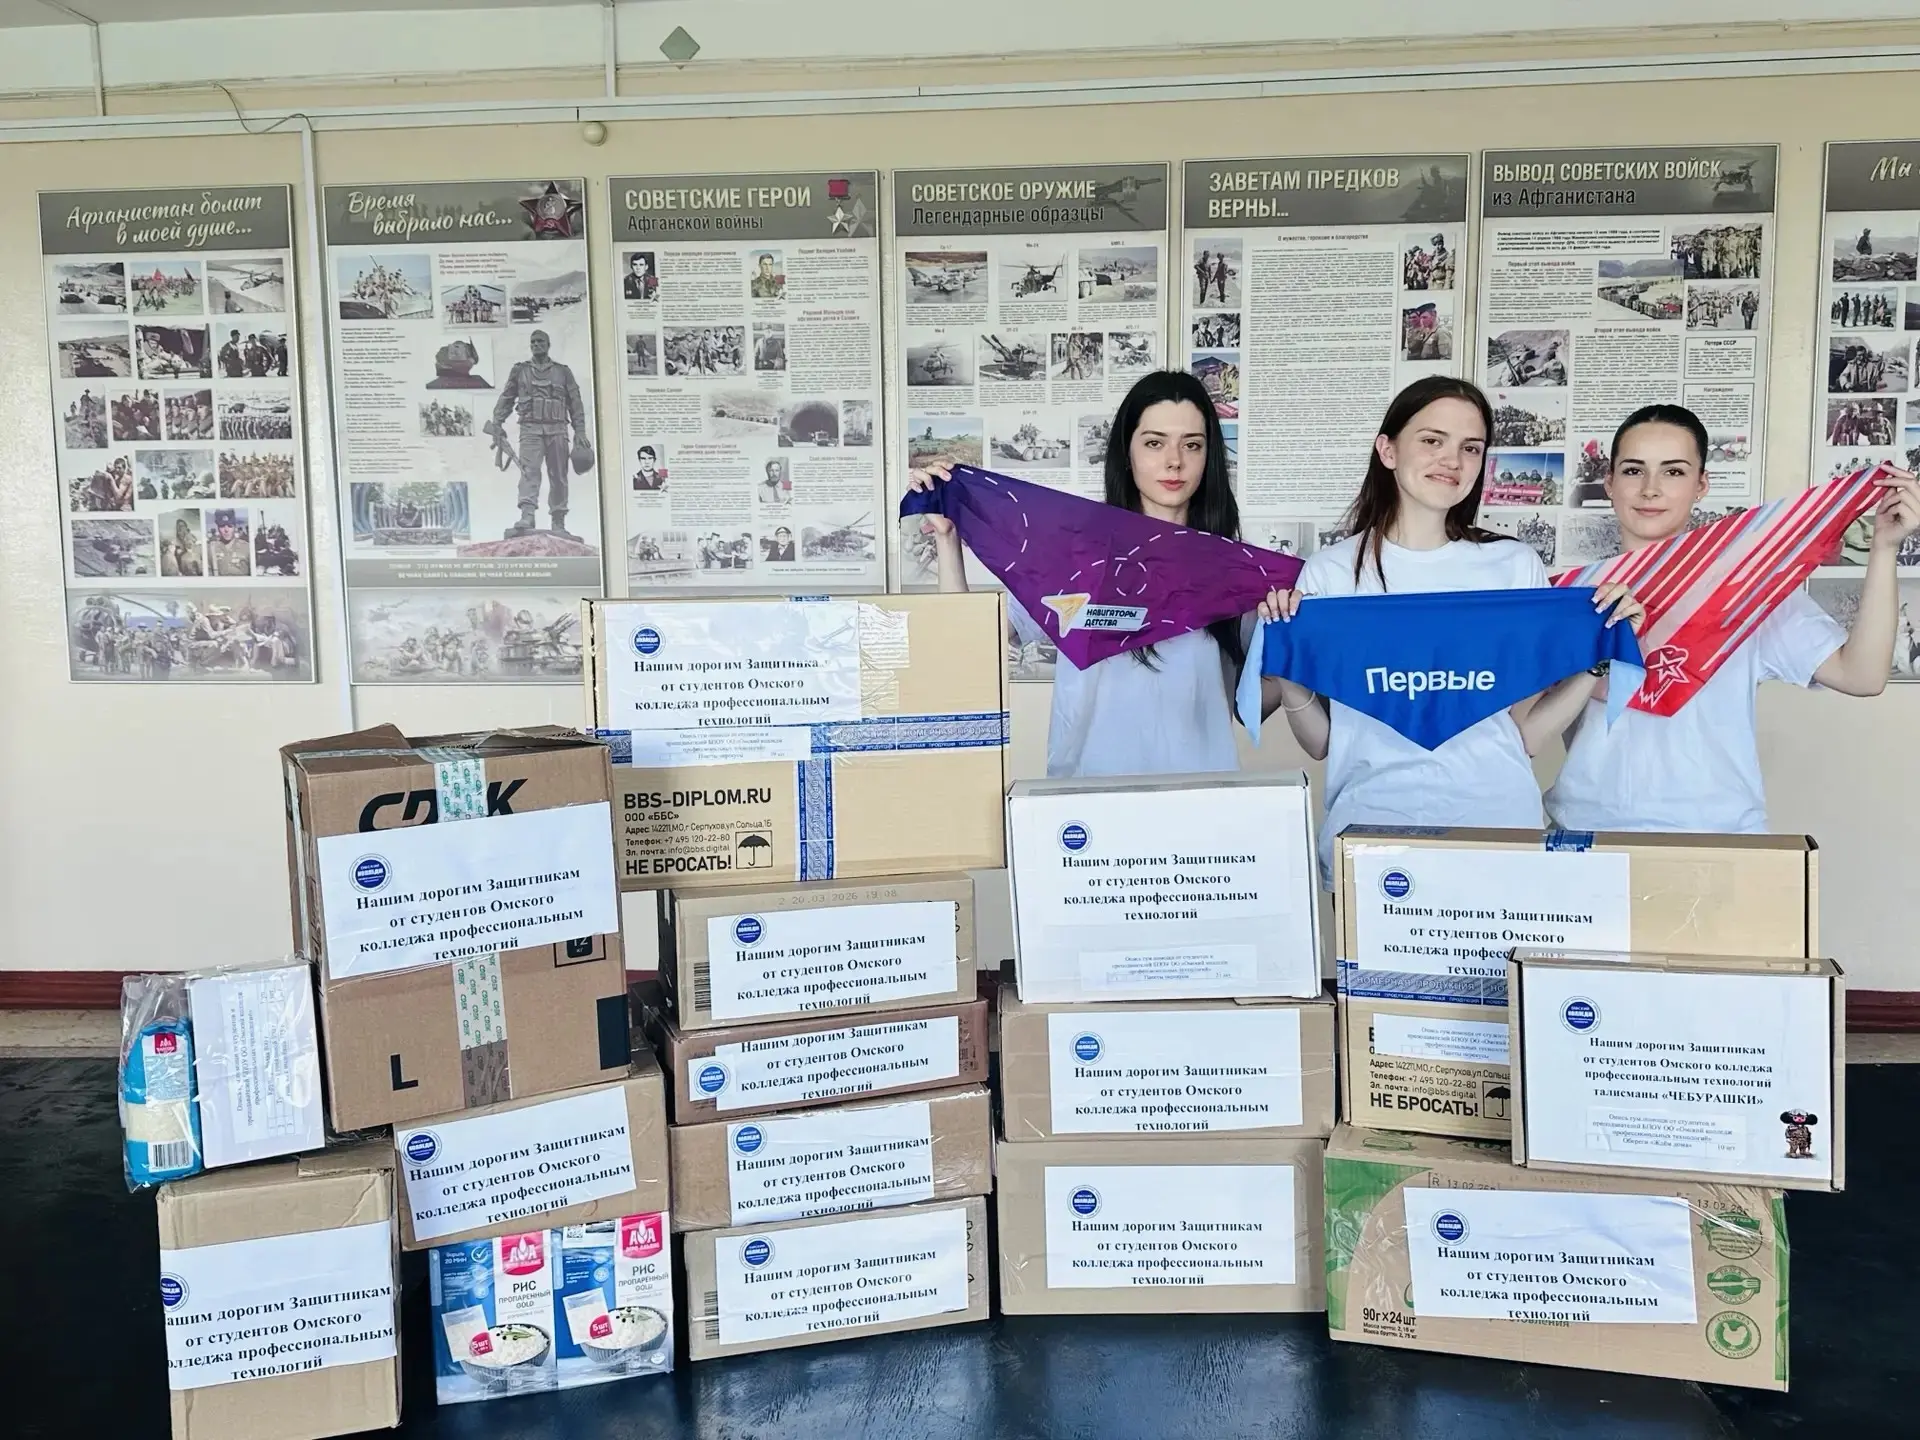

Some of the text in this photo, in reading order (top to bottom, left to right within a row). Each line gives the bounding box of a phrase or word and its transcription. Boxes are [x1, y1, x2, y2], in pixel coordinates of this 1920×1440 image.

[1493, 157, 1721, 184] ВЫВОД СОВЕТСКИХ ВОЙСК
[1870, 156, 1912, 181] Мы
[1209, 168, 1399, 192] ЗАВЕТАМ ПРЕДКОВ
[625, 186, 811, 210] СОВЕТСКИЕ ГЕРОИ
[912, 180, 1096, 203] СОВЕТСКОЕ ОРУЖИЕ
[1493, 188, 1635, 208] из Афганистана
[66, 192, 262, 234] Афганистан болит
[348, 191, 415, 218] Время
[1209, 198, 1289, 219] ВЕРНЫ...
[373, 210, 513, 240] выбрало нас...
[628, 216, 763, 233] Афганской войны
[912, 206, 1104, 226] Легендарные образцы
[117, 220, 251, 247] в моей душе...
[1087, 609, 1137, 617] НАВИГАТОРЫ
[634, 661, 683, 673] Нашим
[686, 660, 742, 674] дорогим
[661, 678, 804, 693] от студентов Омского
[1365, 667, 1496, 700] Первые
[635, 696, 830, 712] колледжа профессиональным
[698, 714, 771, 727] технологий
[358, 778, 529, 833] CDK
[624, 788, 771, 809] BBS-DIPLOM.RU
[625, 811, 679, 821] ООО «ББС»
[692, 834, 730, 842] 120-22-80
[668, 845, 729, 854] info@bbs.digital
[626, 855, 731, 875] НЕ БРОСАТЬ!
[1062, 853, 1256, 869] Нашим дорогим Защитникам
[356, 867, 581, 911] Нашим дорогим Защитникам
[1088, 873, 1231, 888] от студентов Омского
[832, 892, 858, 901] 2026
[1064, 891, 1258, 906] колледжа профессиональным
[389, 894, 554, 928] от студентов Омского
[1124, 908, 1198, 921] технологий
[360, 909, 584, 953] колледжа профессиональным
[433, 937, 519, 961] технологий
[736, 934, 925, 962] Нашим дорогим Защитникам
[762, 955, 902, 979] от студентов Омского
[736, 970, 927, 1000] колледжа профессиональным
[798, 994, 870, 1011] технологий
[1590, 1037, 1766, 1055] Нашим дорогим Защитникам
[390, 1053, 418, 1091] L
[1583, 1056, 1773, 1074] от студентов Омского колледжа
[1370, 1071, 1476, 1088] Телефон: 120-22-80
[1585, 1070, 1772, 1088] профессиональным технологий
[1370, 1092, 1478, 1116] НЕ БРОСАТЬ!
[1594, 1088, 1763, 1105] талисманы «ЧЕБУРАШКИ»
[409, 1125, 625, 1181] Нашим дорогим Защитникам
[442, 1153, 601, 1196] от студентов Омского
[416, 1164, 631, 1221] колледжа профессиональным
[486, 1196, 569, 1224] технологий
[619, 1273, 669, 1287] ПРОПАРЕННЫЙ
[632, 1264, 656, 1276] РИС
[498, 1291, 551, 1304] ПРОПАРЕННЫЙ
[513, 1281, 537, 1293] РИС
[166, 1286, 391, 1326] ашим дорогим Защитникам
[516, 1301, 534, 1309] GOLD
[186, 1313, 362, 1347] от студентов Омского
[167, 1327, 393, 1369] олледжа профессиональным
[231, 1356, 323, 1381] технологий
